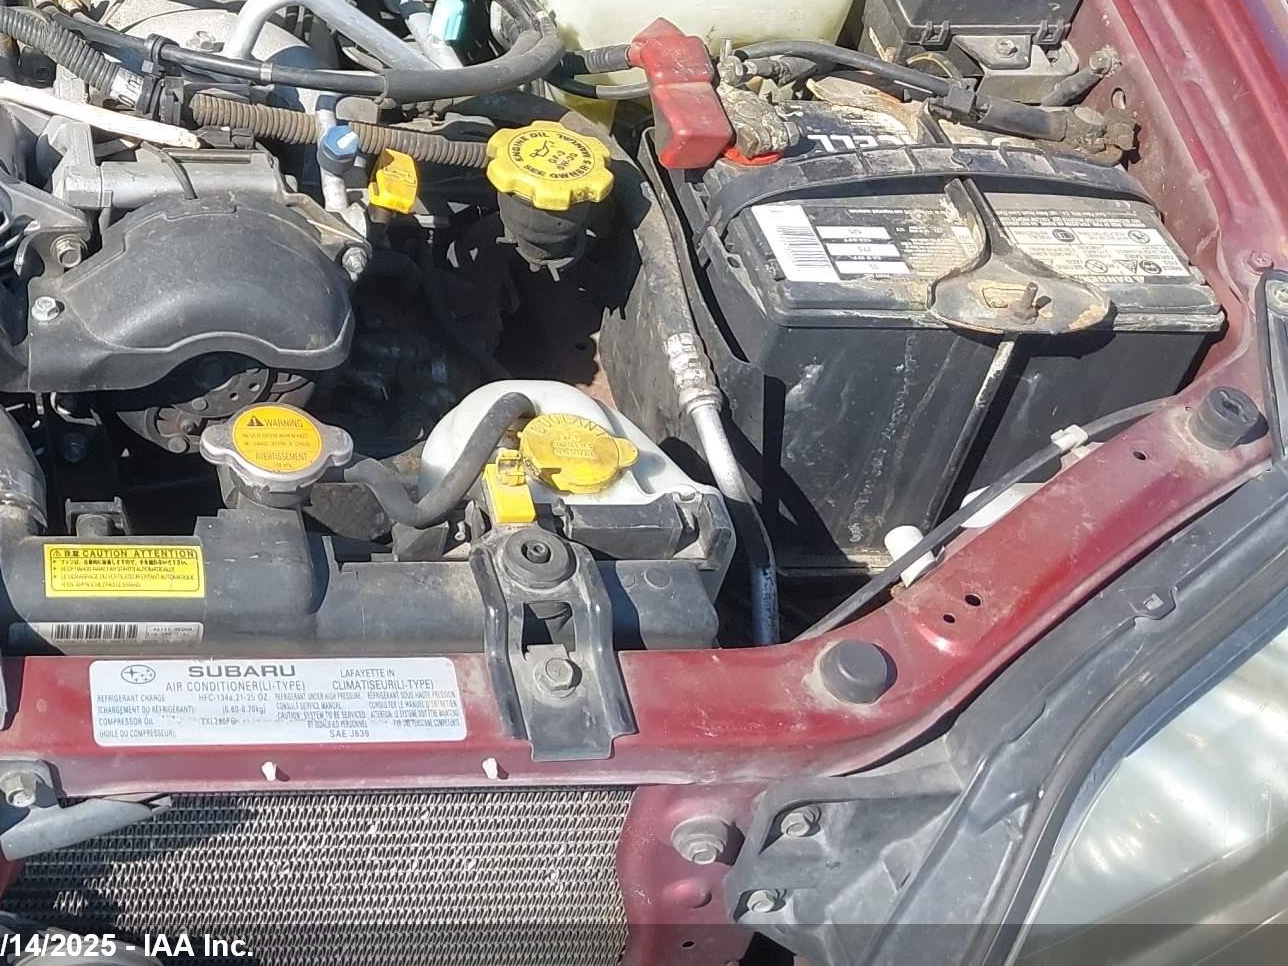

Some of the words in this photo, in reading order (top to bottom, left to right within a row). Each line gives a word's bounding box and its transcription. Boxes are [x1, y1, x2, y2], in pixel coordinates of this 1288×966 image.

[512, 136, 528, 161] ENGINE
[524, 165, 546, 176] SEE
[264, 418, 303, 427] WARNING
[256, 452, 307, 460] AVERTISSEMENT
[83, 550, 128, 558] CAUTION
[134, 550, 194, 558] ATTENTION
[188, 665, 296, 678] SUBARU
[340, 669, 384, 677] LAFAYETTE
[386, 668, 395, 677] IN
[166, 682, 182, 692] AIR
[186, 679, 305, 692] CONDITIONER(LI-TYPE)
[332, 679, 434, 690] CLIMATISEUR(LI-TYPE)
[99, 718, 142, 726] COMPRESSOR
[99, 729, 118, 738] (HUILE
[120, 729, 129, 737] DU
[330, 730, 347, 738] SAE
